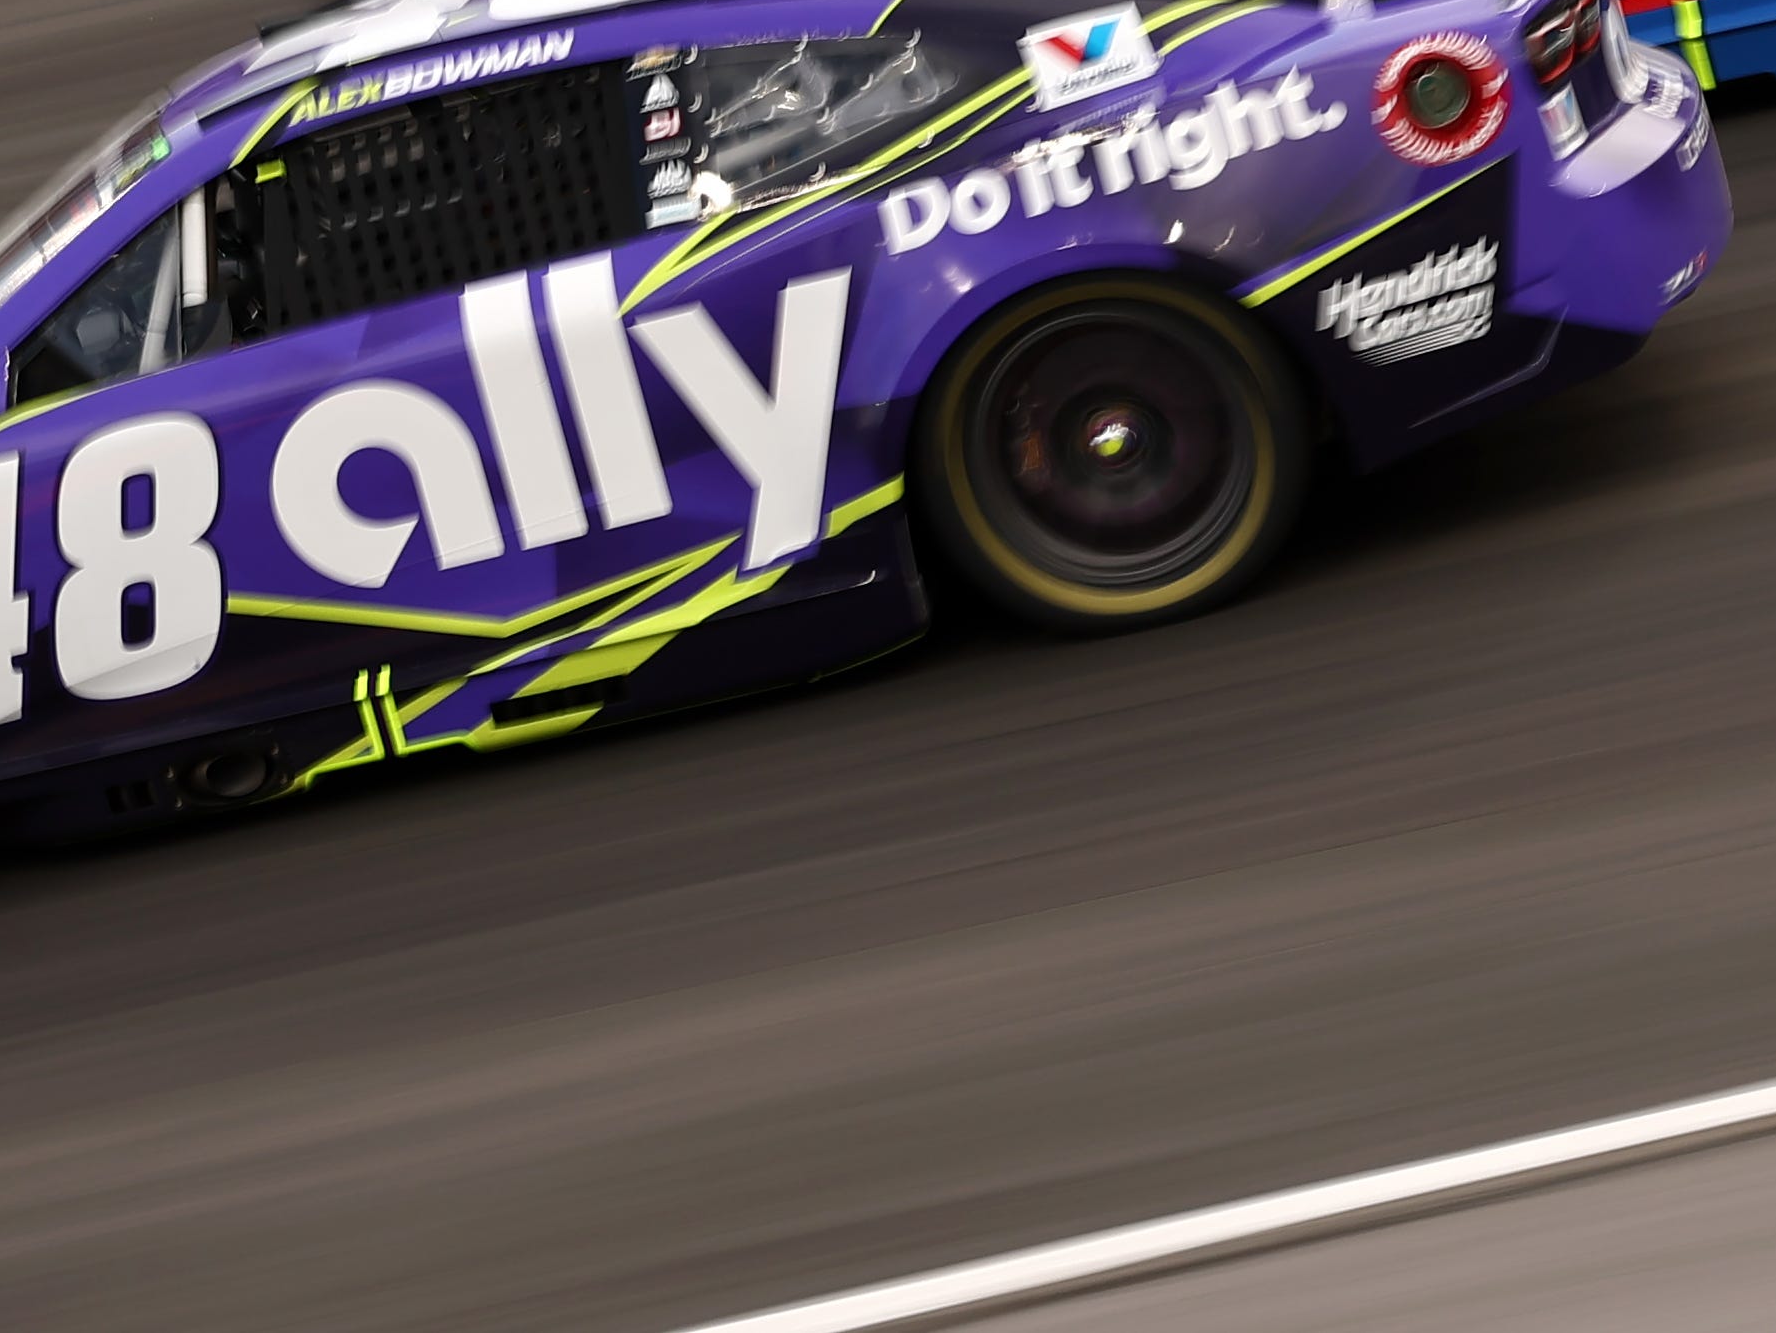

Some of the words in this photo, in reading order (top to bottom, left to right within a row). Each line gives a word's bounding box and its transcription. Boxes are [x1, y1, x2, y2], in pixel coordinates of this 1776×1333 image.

[877, 166, 1011, 257] Do
[1090, 63, 1349, 196] right.
[269, 250, 853, 589] ally
